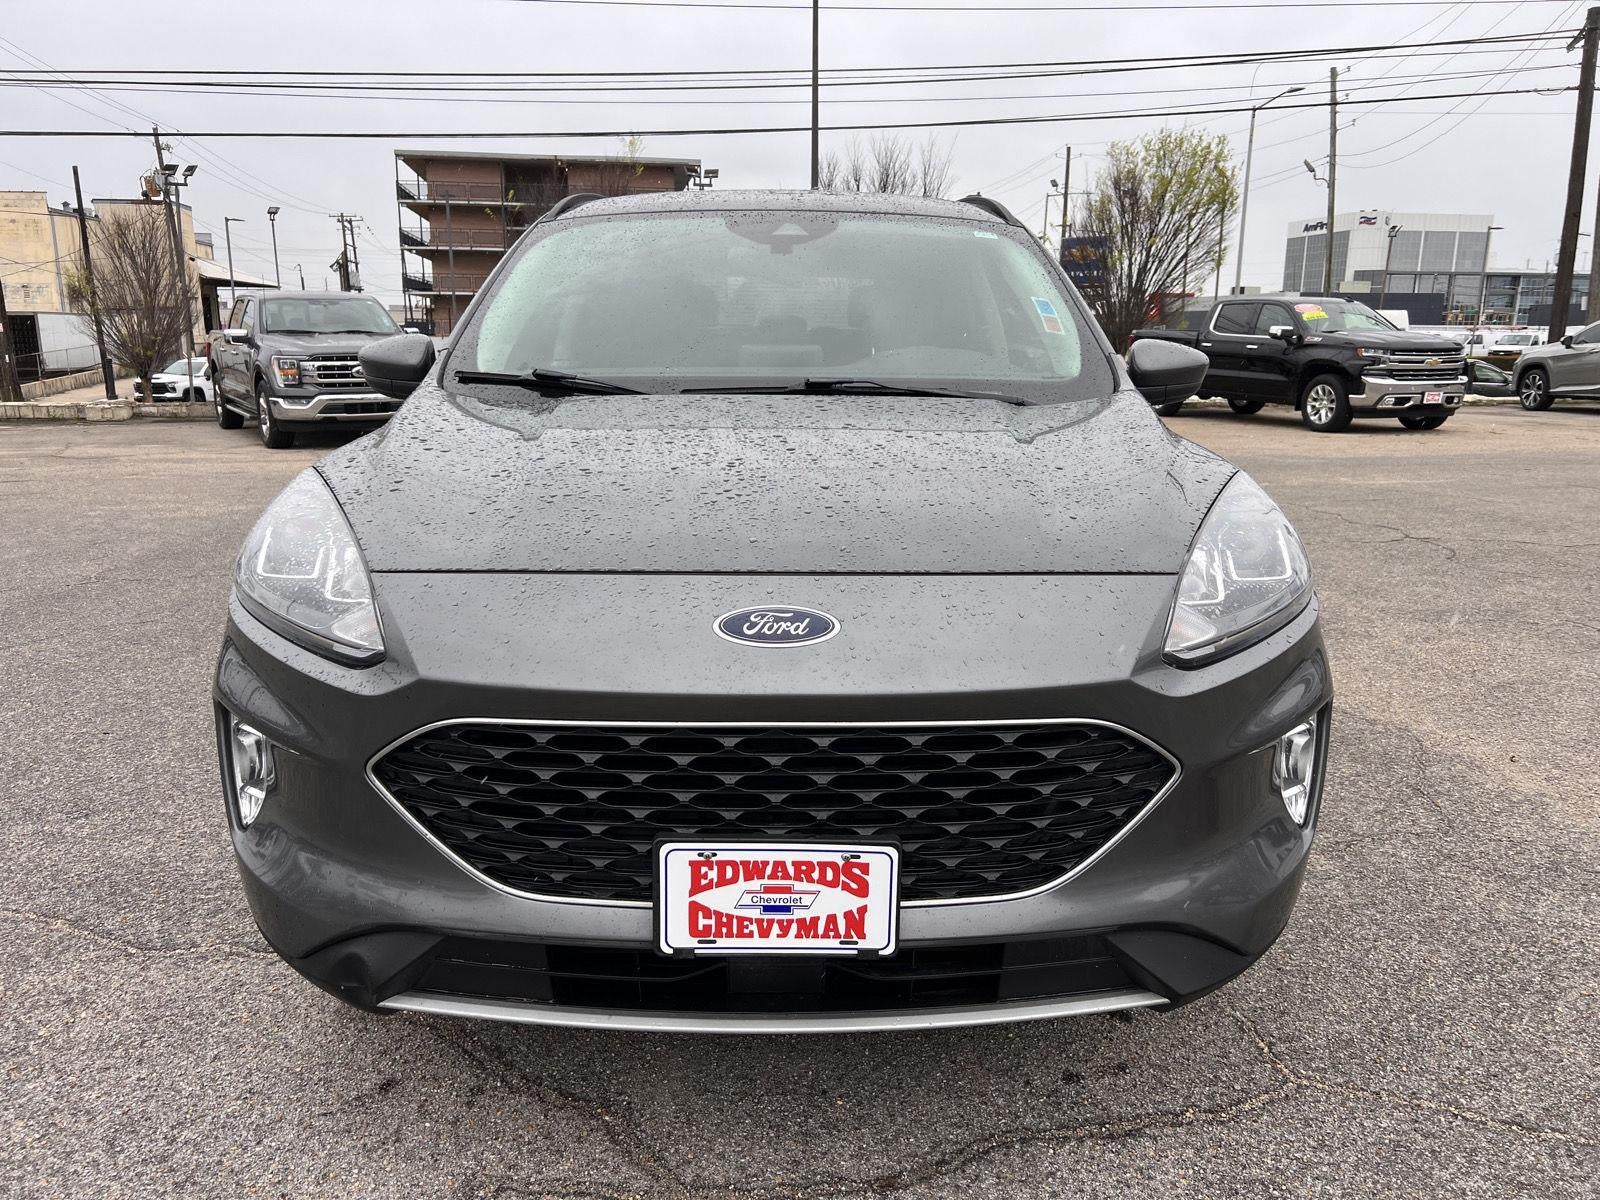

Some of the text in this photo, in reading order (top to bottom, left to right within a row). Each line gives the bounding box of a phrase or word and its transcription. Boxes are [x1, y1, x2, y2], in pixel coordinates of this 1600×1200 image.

[742, 611, 811, 635] Ford
[688, 859, 870, 898] EDWARDS
[750, 895, 803, 905] Chevrolet
[688, 900, 868, 940] CHEVYMAN
